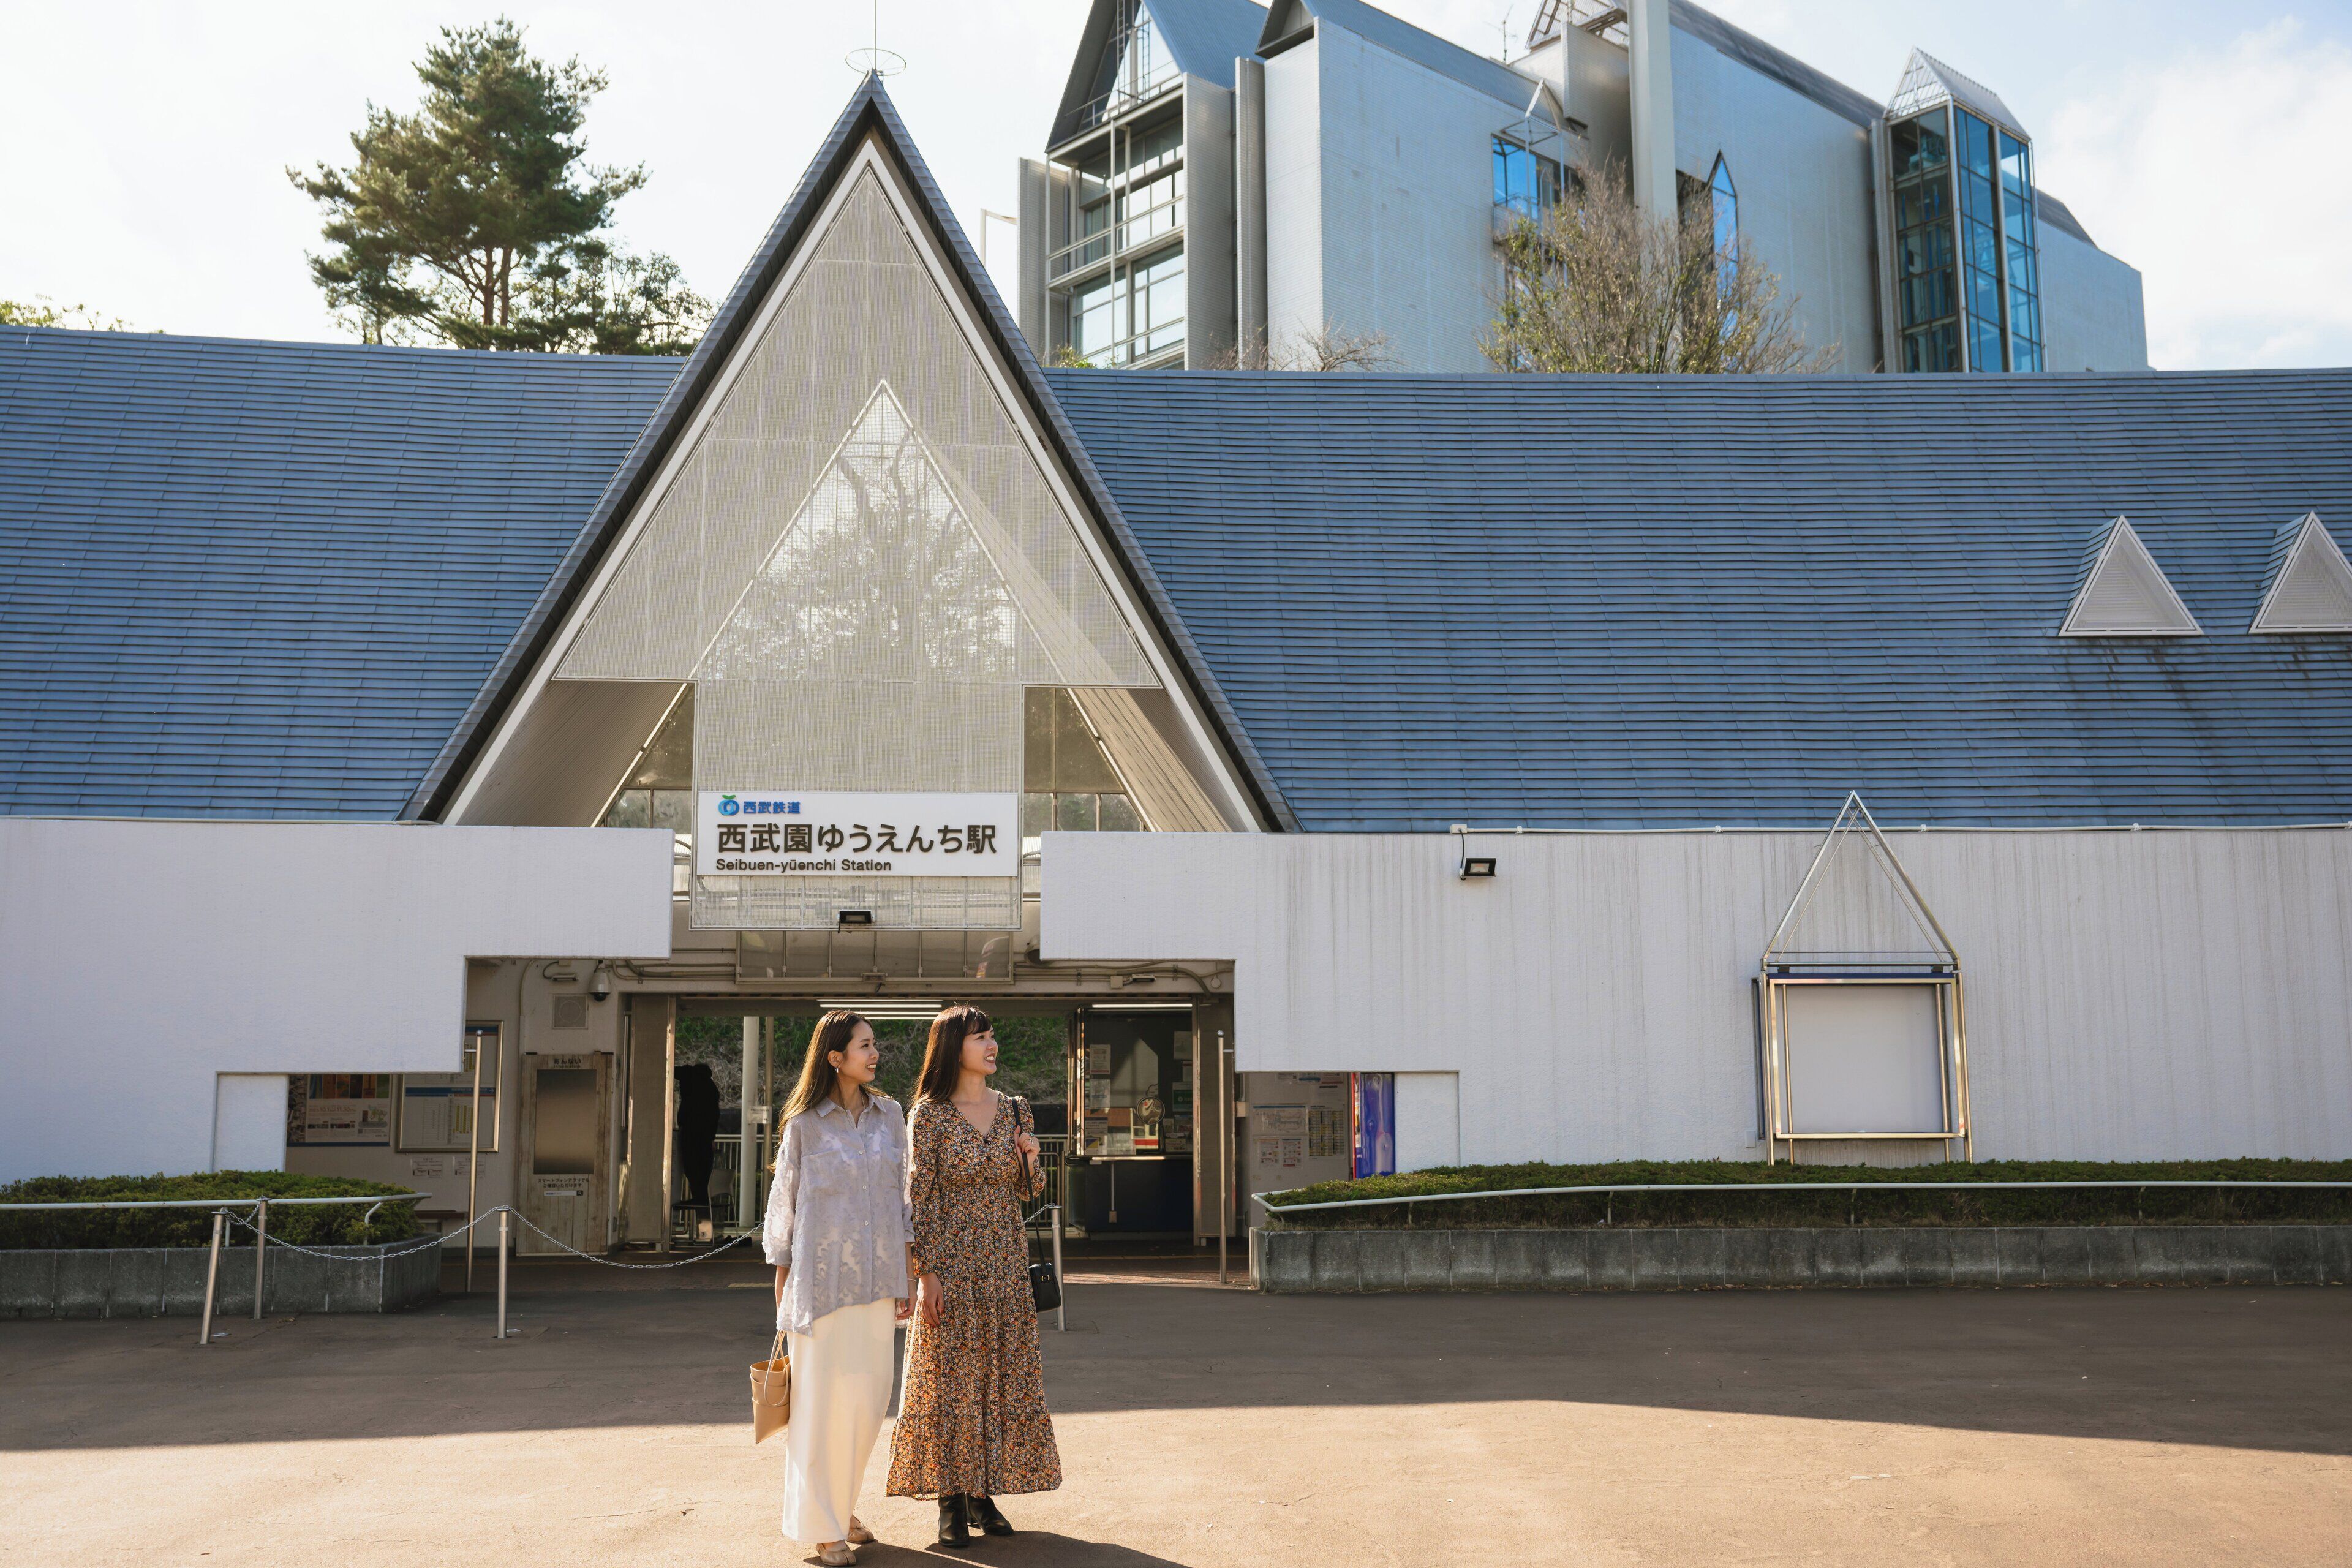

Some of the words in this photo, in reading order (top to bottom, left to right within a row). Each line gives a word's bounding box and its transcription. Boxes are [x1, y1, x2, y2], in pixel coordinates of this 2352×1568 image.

[743, 801, 801, 815] 西武鉄道
[717, 823, 997, 854] 西武園ゆうえんち駅
[715, 858, 836, 873] Seibuen-yūenchi
[841, 858, 892, 872] Station
